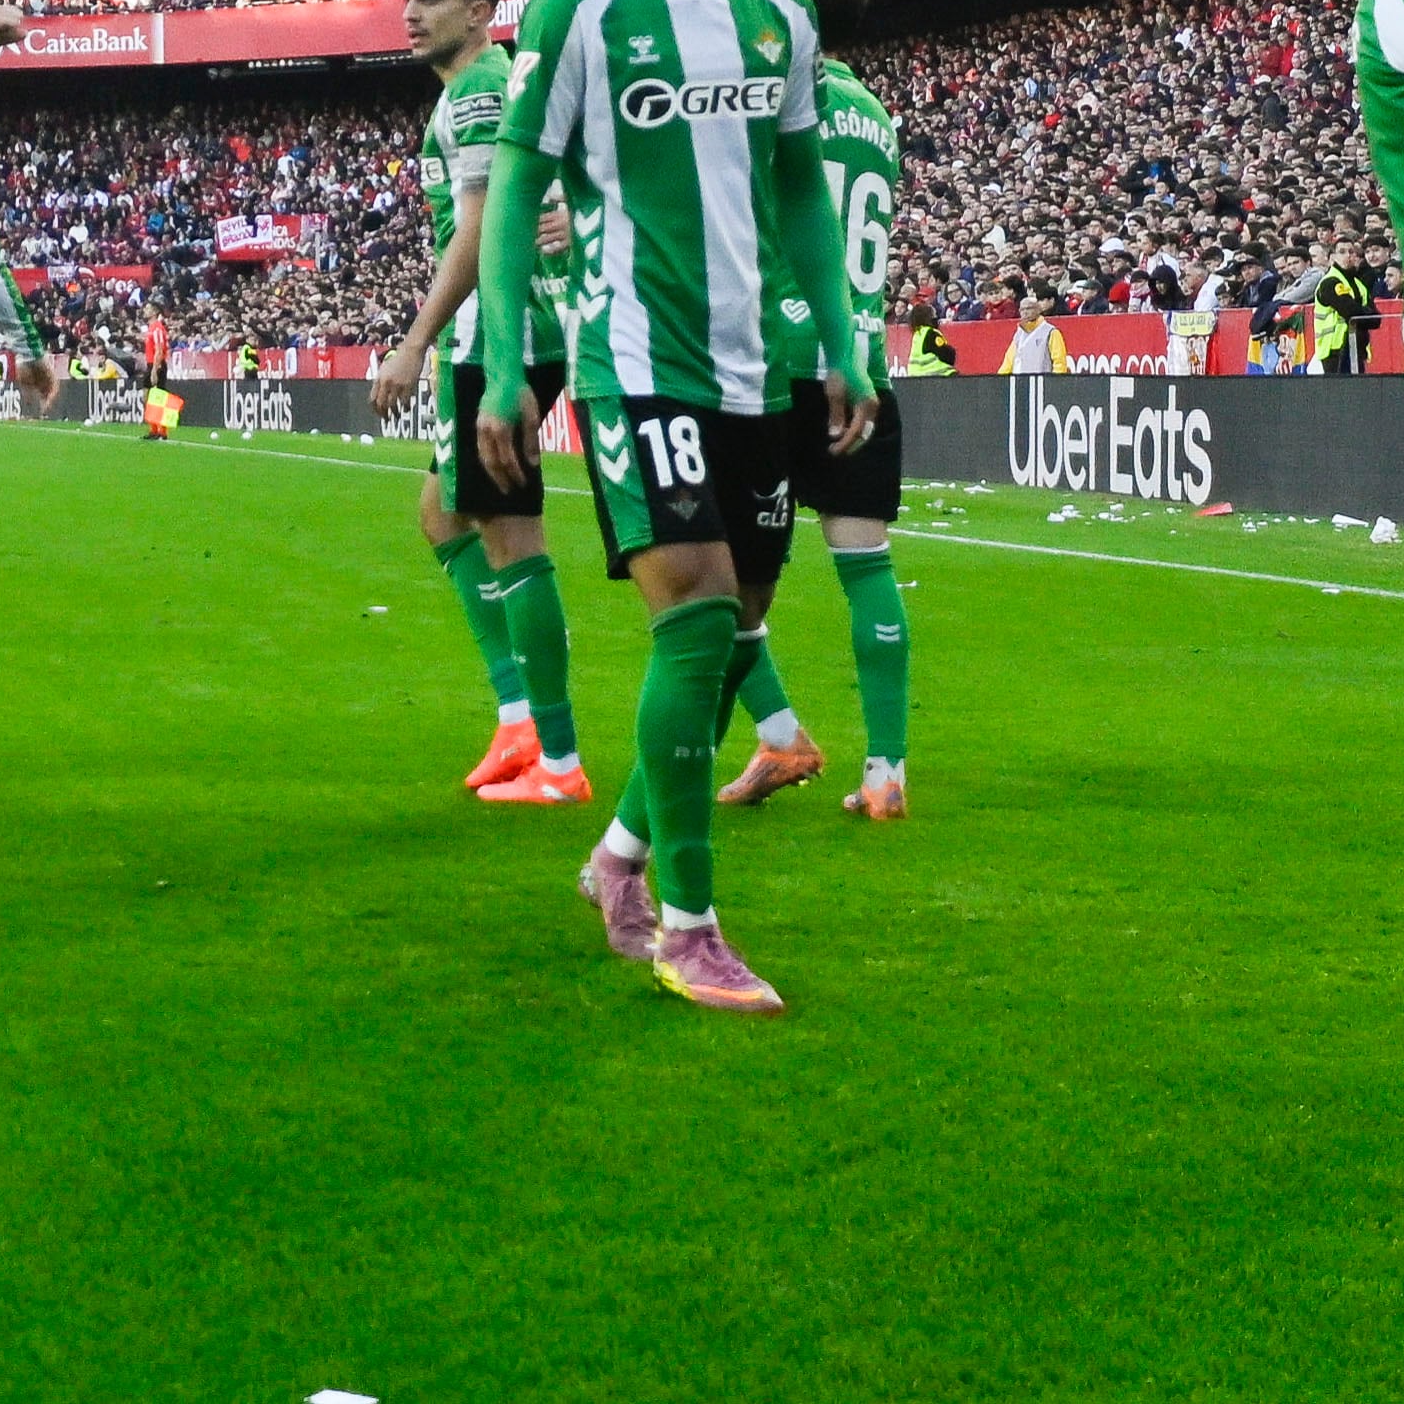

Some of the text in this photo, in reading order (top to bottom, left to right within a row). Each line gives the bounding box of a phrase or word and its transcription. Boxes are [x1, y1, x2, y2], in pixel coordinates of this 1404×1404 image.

[24, 25, 149, 56] CaixaBank
[1066, 353, 1168, 376] ocioscom
[223, 379, 293, 432] Uber Eats
[637, 415, 707, 488] 18
[1007, 376, 1213, 506] Uber Eats
